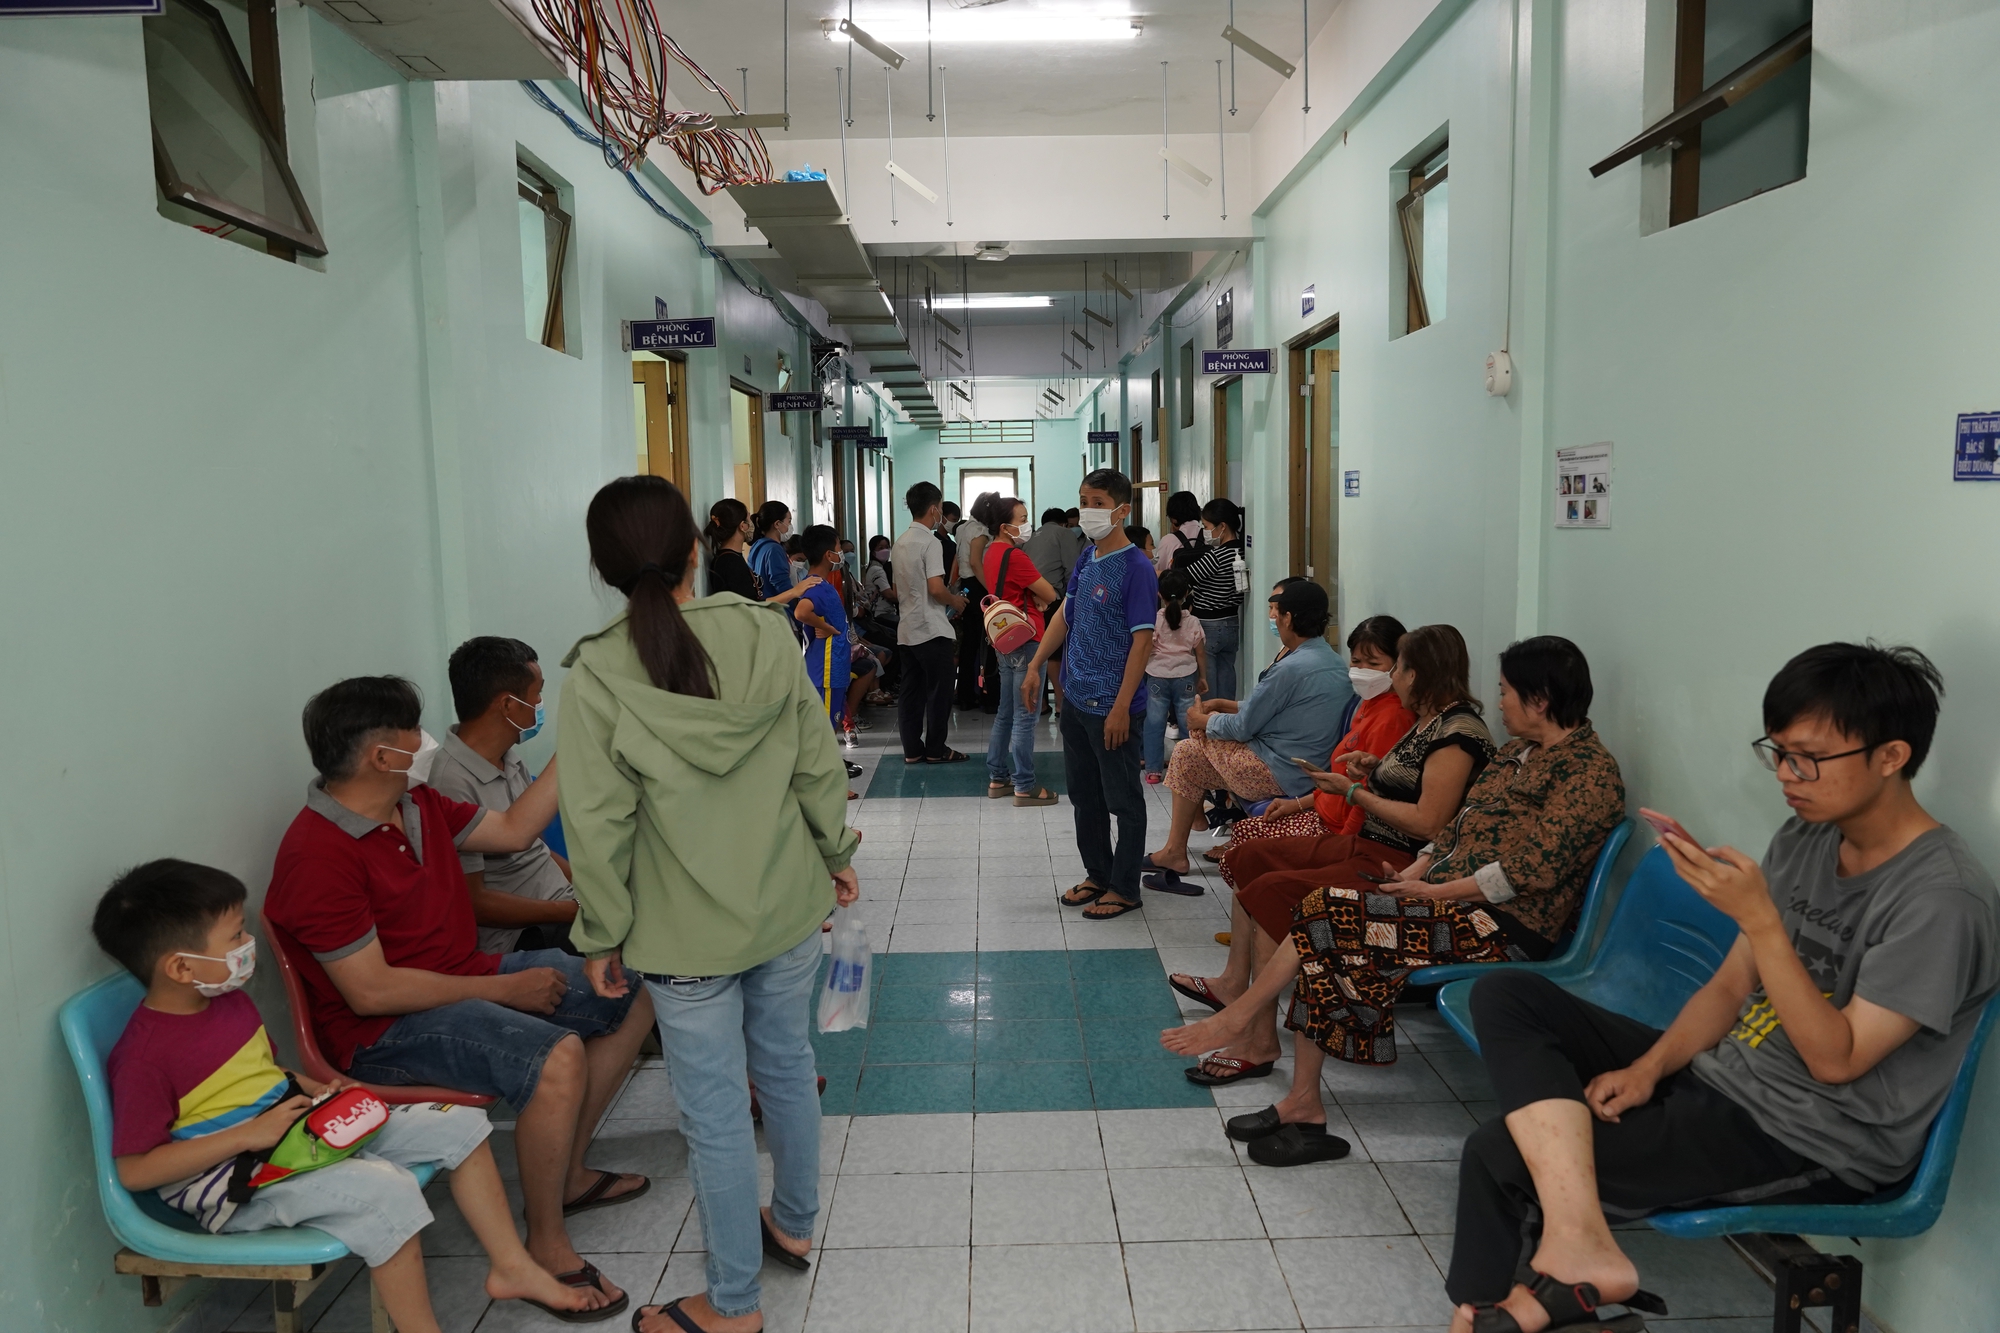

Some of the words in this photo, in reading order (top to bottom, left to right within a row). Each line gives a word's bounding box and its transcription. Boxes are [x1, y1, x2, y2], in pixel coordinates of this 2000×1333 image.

[656, 322, 690, 332] PHÒNG
[642, 333, 679, 347] BỆNH
[683, 331, 705, 343] NỮ
[1222, 351, 1250, 360] PHÒNG
[1208, 361, 1237, 372] BỆNH
[1240, 361, 1264, 370] NAM
[777, 401, 800, 409] BỆNH
[802, 400, 817, 408] NỮ
